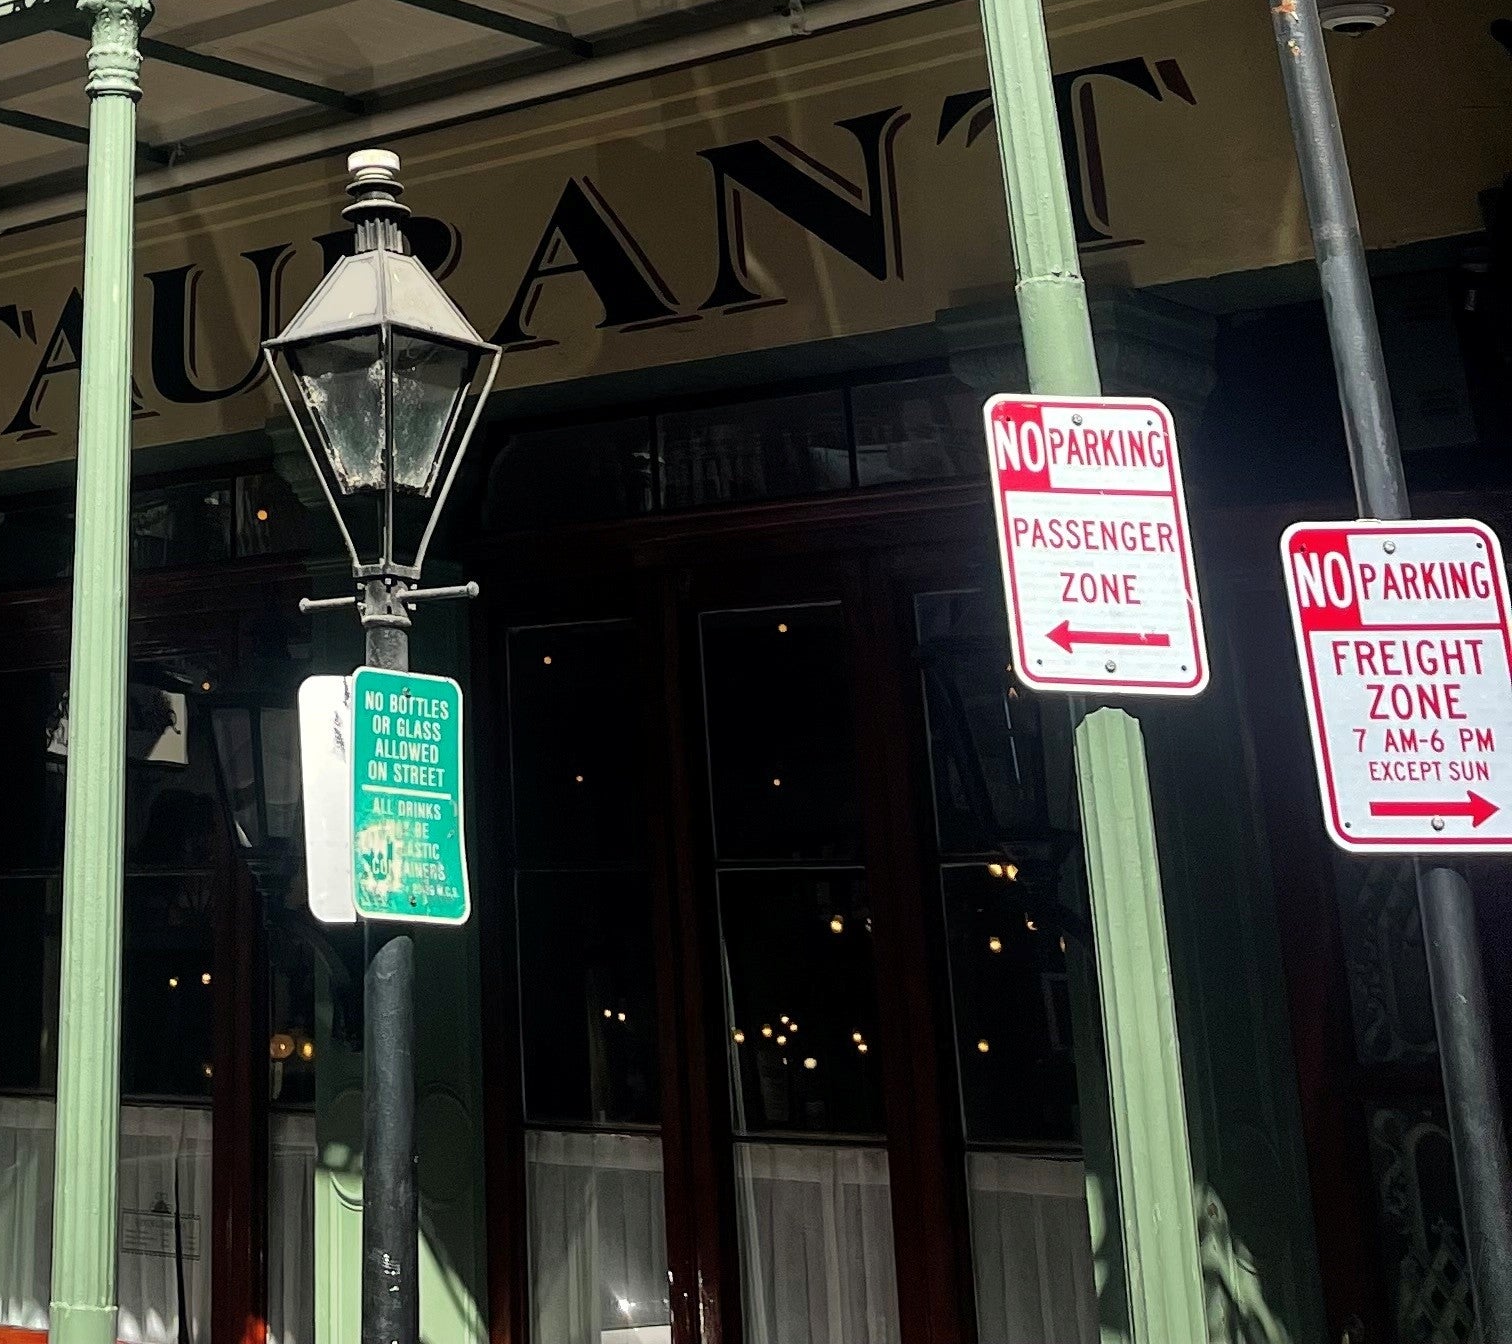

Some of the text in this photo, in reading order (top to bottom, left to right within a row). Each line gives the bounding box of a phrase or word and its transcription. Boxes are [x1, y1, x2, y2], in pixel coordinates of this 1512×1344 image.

[994, 420, 1165, 472] NO PARKING
[1014, 518, 1175, 552] PASSENGER
[1060, 572, 1141, 604] ZONE
[1294, 552, 1489, 608] NO PARKING
[1332, 640, 1483, 675] FREIGHT
[365, 691, 384, 711] NO
[389, 694, 449, 720] BOTTLES
[1367, 684, 1466, 720] ZONE
[372, 715, 441, 742] OR GLASS
[1352, 728, 1495, 752] 7 AM-6 PM
[375, 738, 439, 764] ALLOWED
[368, 760, 445, 787] ON STREET
[1368, 761, 1489, 781] EXCEPT SUN
[373, 797, 441, 820] ALL DRINKS
